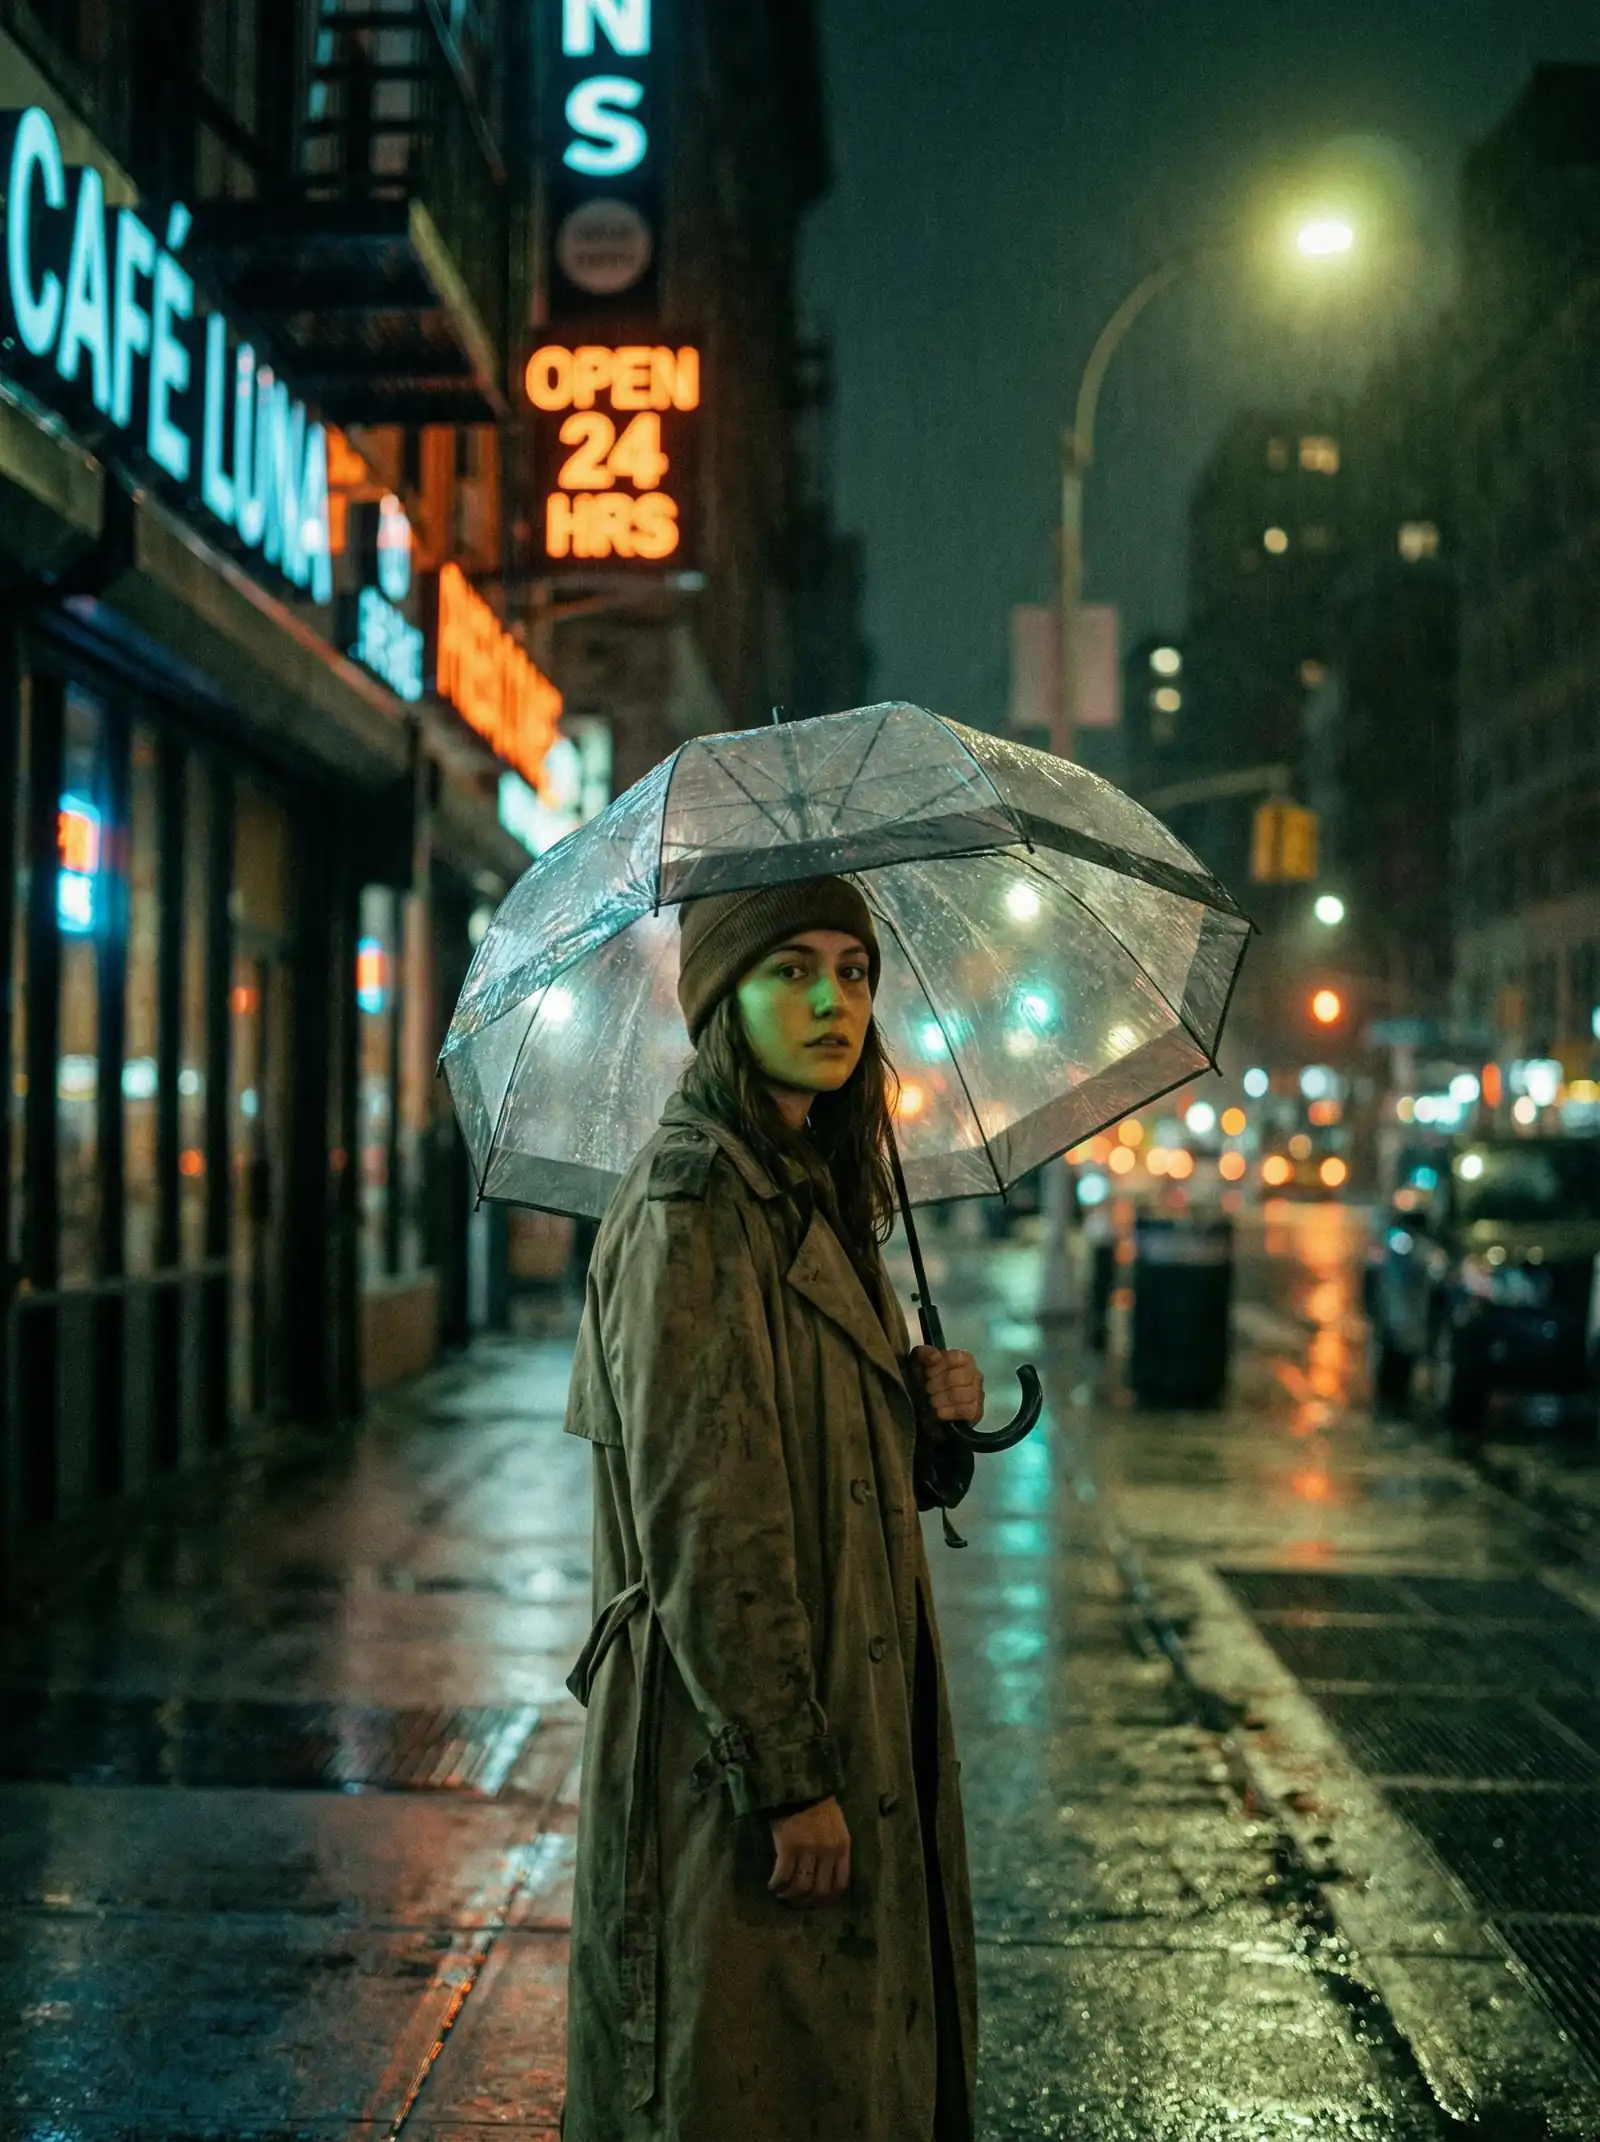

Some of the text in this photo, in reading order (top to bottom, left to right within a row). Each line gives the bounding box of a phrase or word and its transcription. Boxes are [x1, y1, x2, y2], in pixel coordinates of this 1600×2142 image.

[7, 105, 333, 606] CAFÉ LUNA
[525, 345, 700, 411] OPEN
[558, 411, 669, 489] 24
[546, 492, 679, 559] HRS
